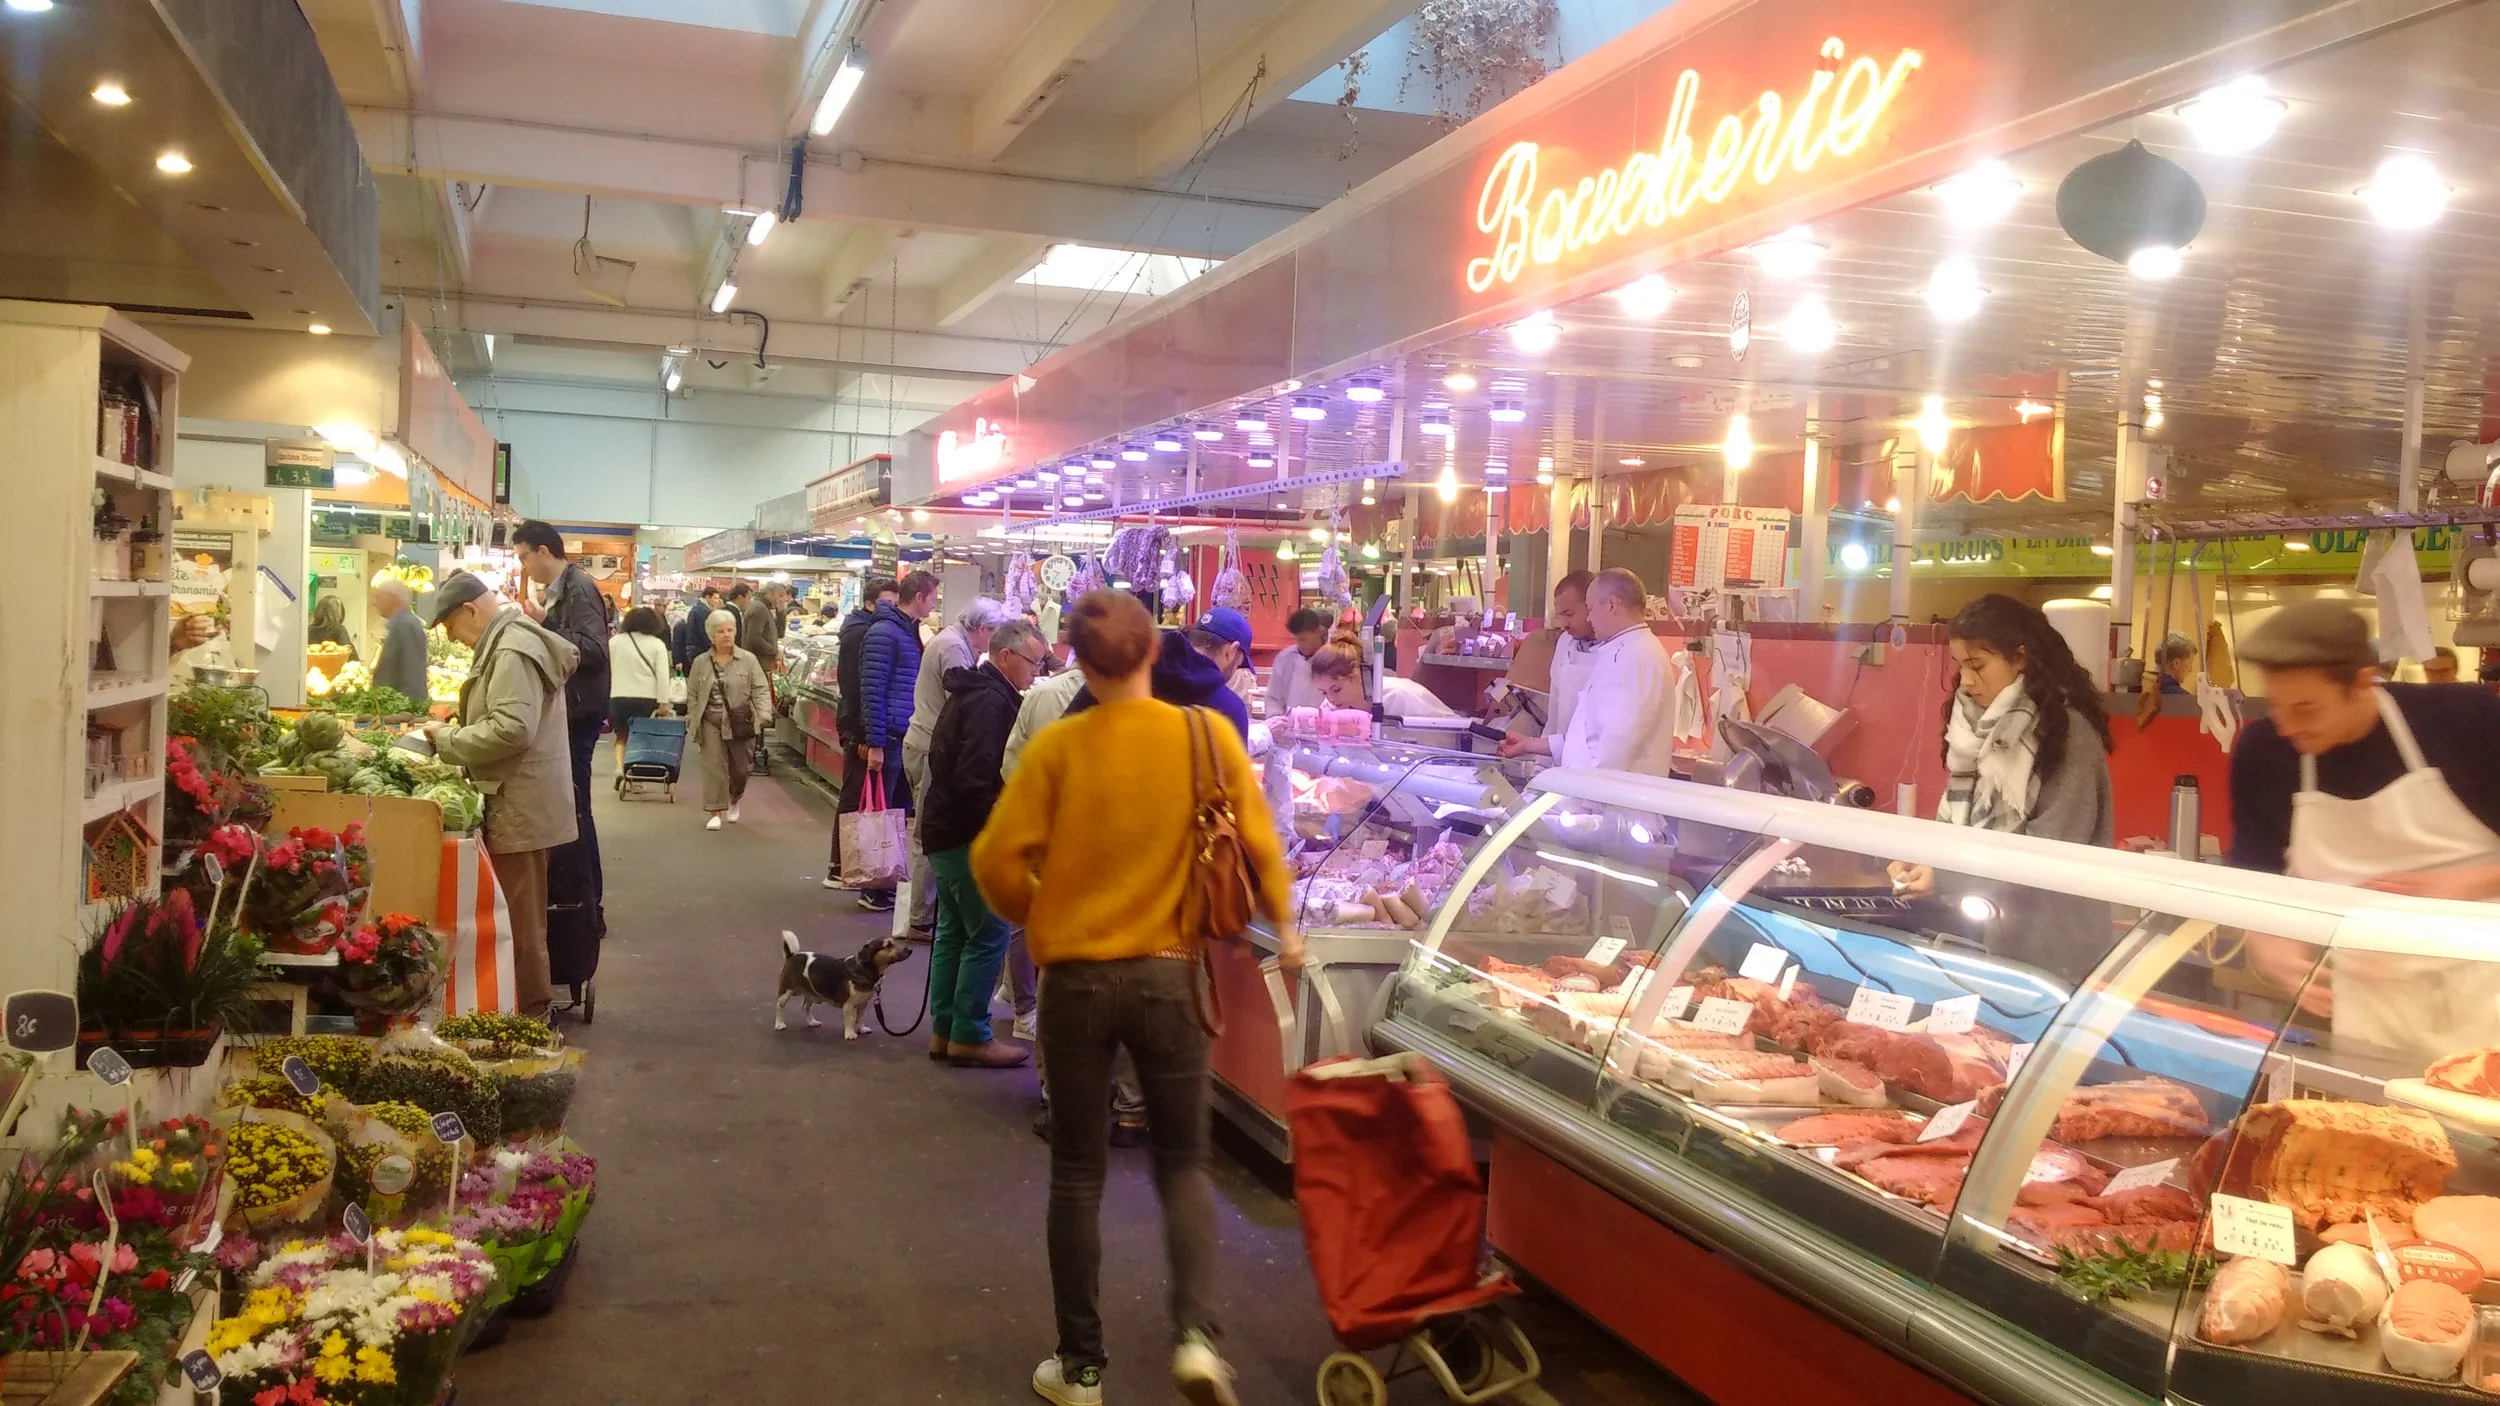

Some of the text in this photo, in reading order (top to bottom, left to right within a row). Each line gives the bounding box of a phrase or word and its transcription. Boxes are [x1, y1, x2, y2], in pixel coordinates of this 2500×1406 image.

[1467, 36, 1922, 293] Boucherie
[1709, 507, 1753, 521] PORC
[1939, 538, 2005, 562] OEUFS
[15, 1014, 38, 1037] 8€
